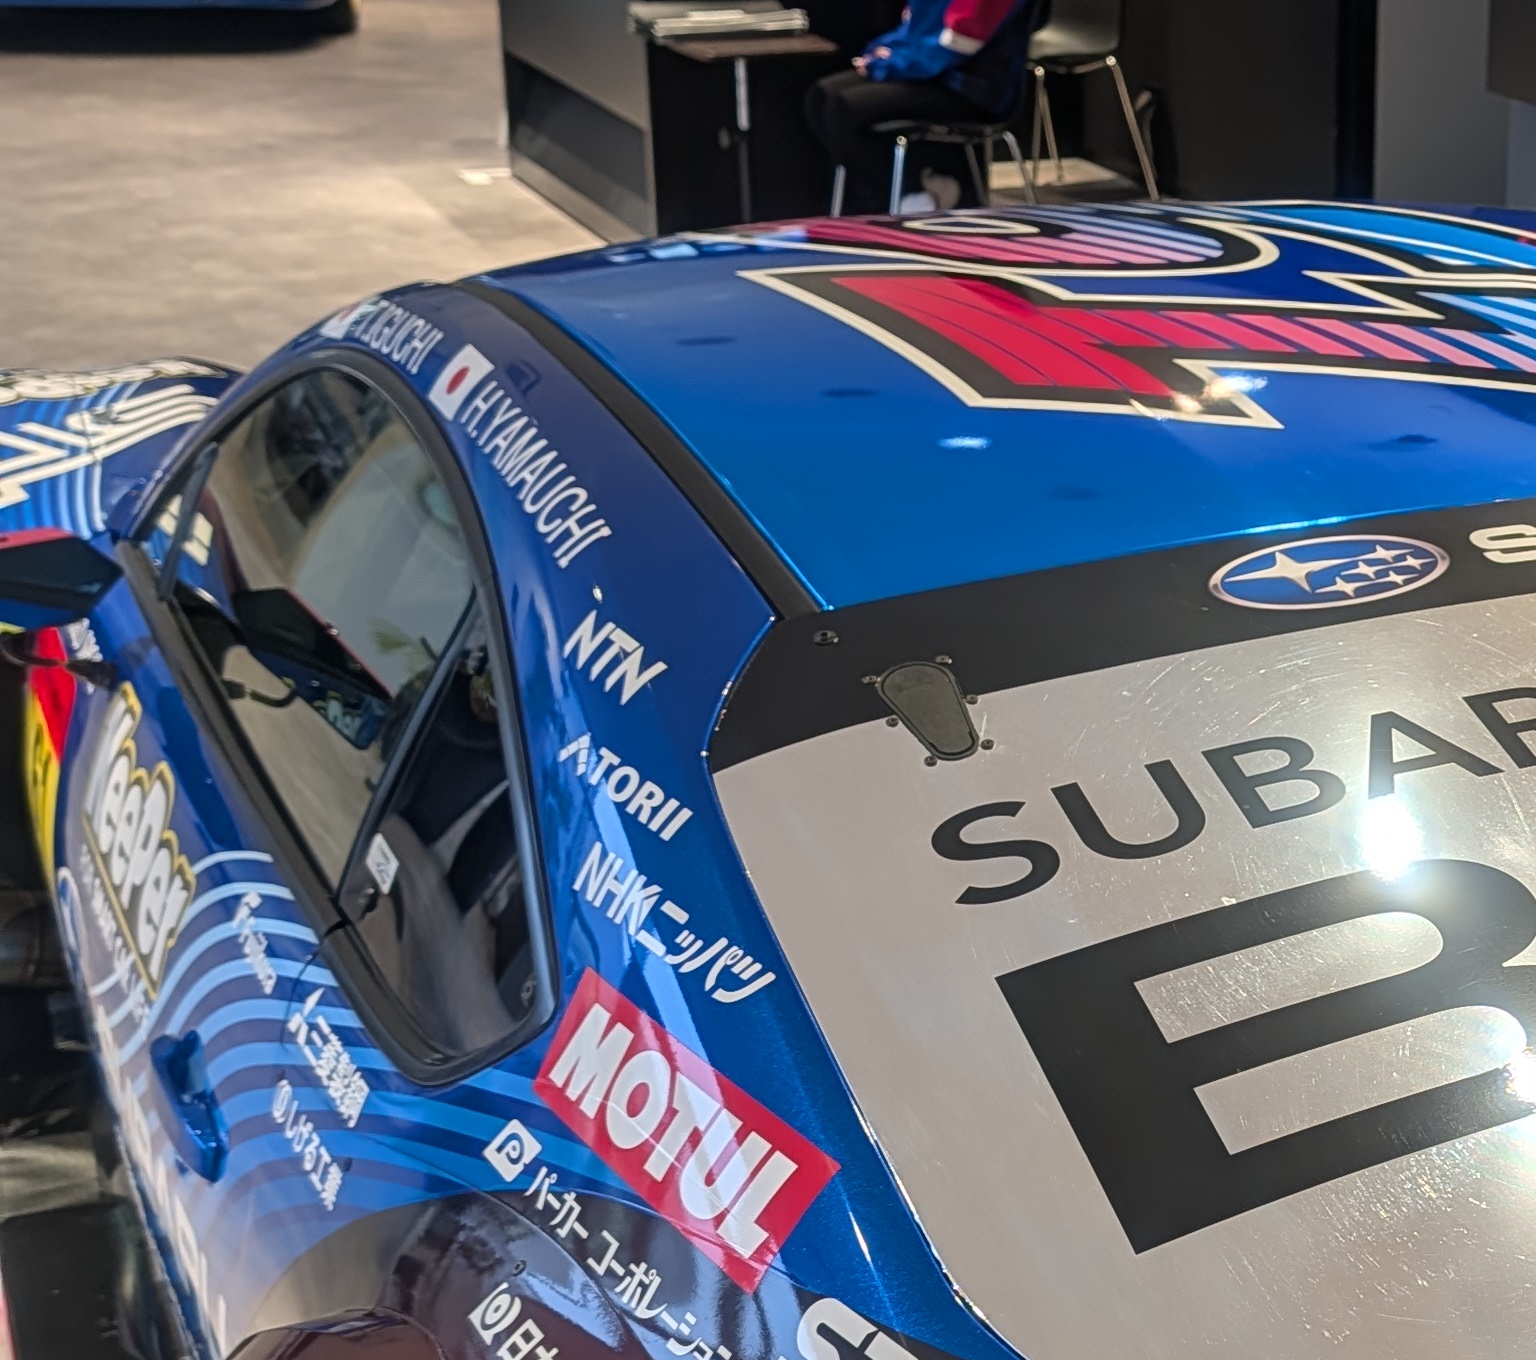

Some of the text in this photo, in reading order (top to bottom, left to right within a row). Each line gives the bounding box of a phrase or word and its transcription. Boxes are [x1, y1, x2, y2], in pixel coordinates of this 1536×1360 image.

[460, 379, 612, 570] H.YAMAUCHI
[562, 607, 669, 707] NTN
[572, 841, 776, 1004] NHKニッパツ
[549, 1002, 798, 1261] MOTUL
